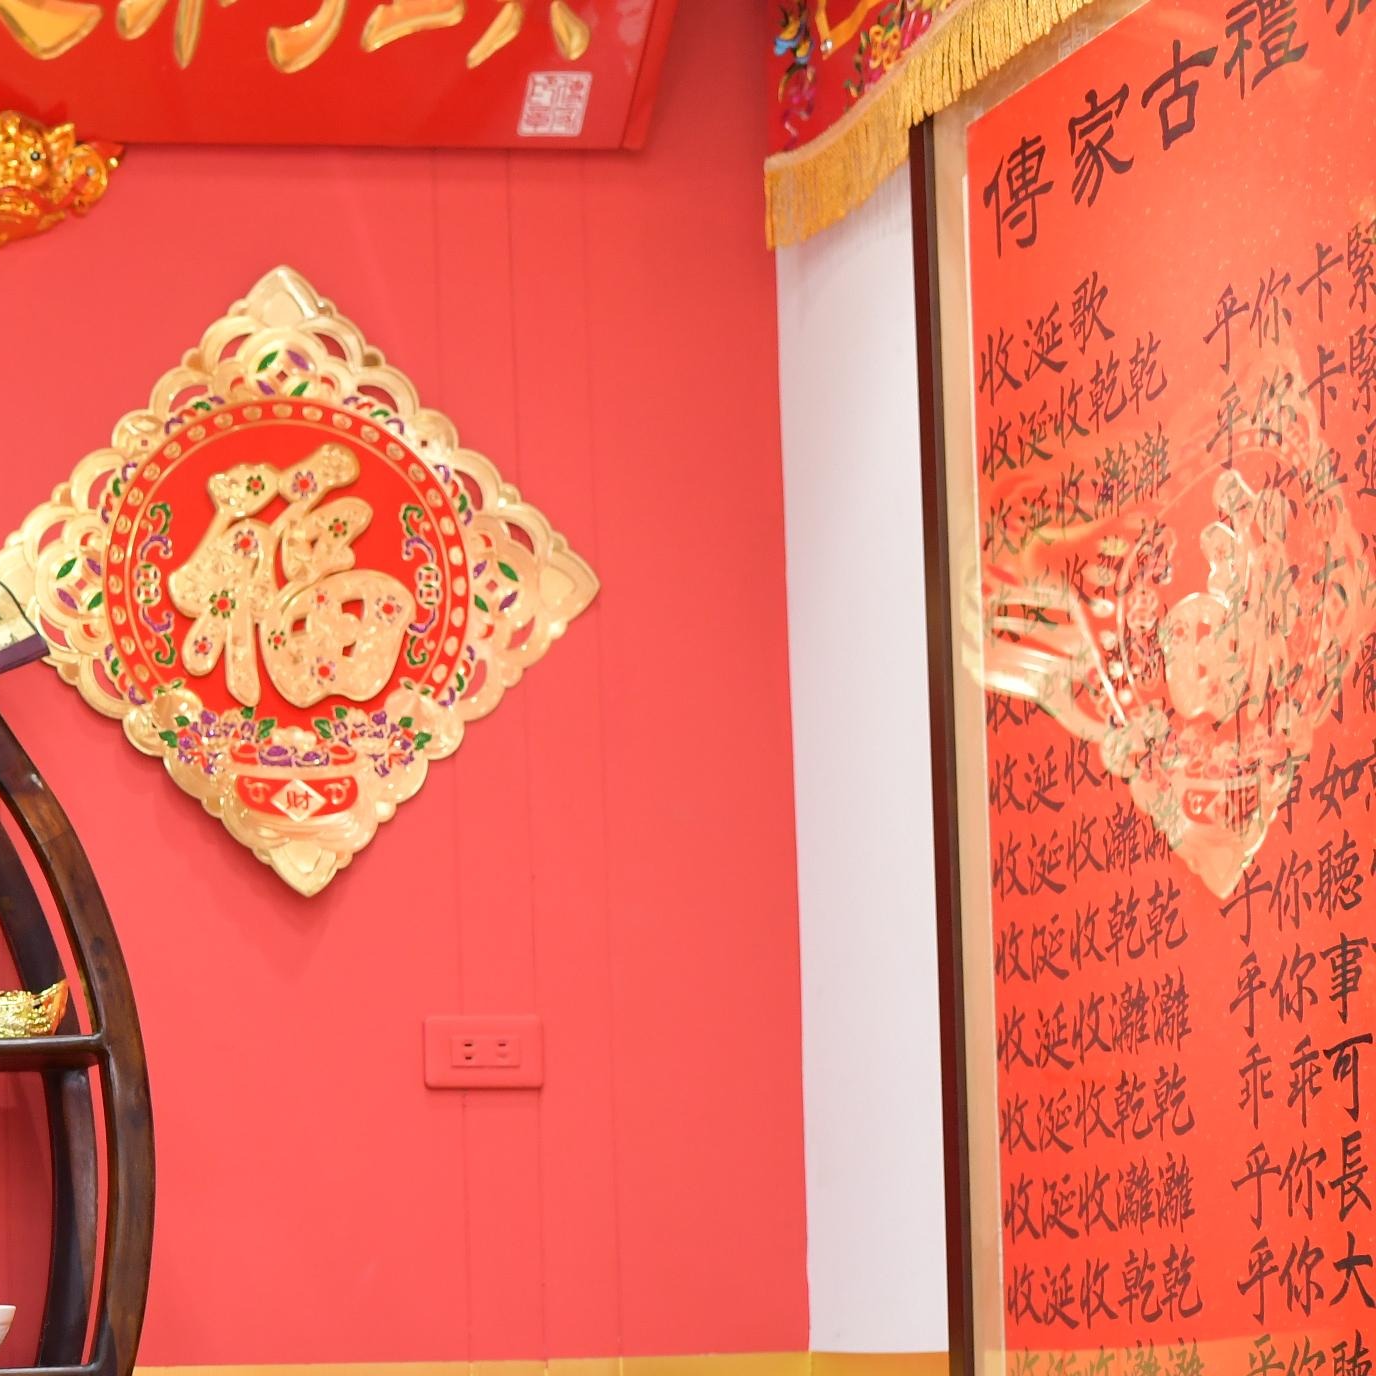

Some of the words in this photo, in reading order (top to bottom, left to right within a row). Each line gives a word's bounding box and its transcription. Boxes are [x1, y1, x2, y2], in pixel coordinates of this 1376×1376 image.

[979, 271, 1116, 405] 收涎歌
[169, 444, 417, 707] 福
